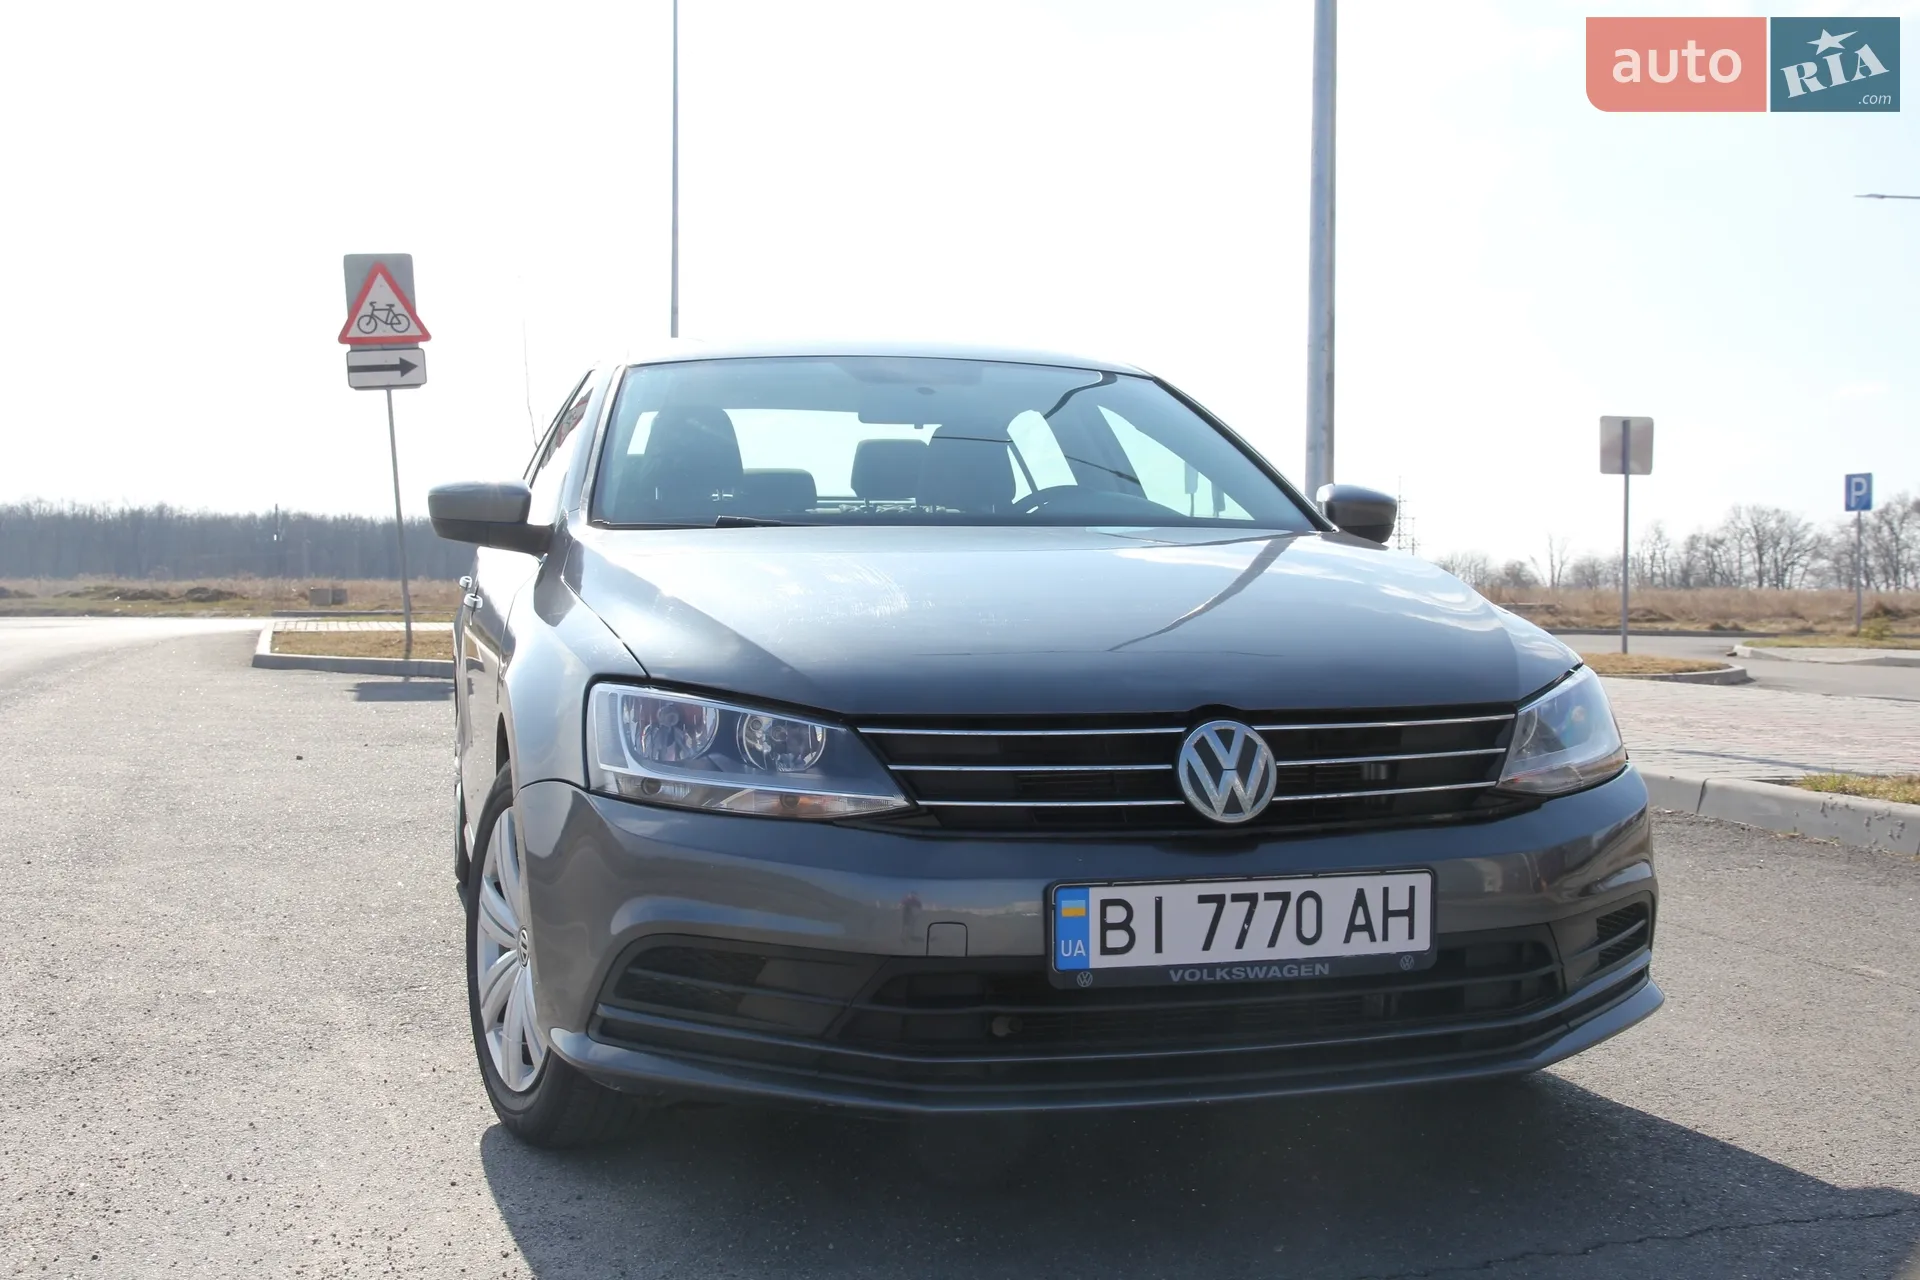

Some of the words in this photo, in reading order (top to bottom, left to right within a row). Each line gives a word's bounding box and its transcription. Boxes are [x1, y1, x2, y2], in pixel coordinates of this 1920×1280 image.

[1850, 477, 1867, 508] P
[1099, 896, 1164, 956] BI
[1197, 889, 1323, 952] 7770
[1342, 885, 1416, 945] AH
[1060, 939, 1087, 958] UA
[1168, 962, 1330, 983] VOLKSWAGEN
